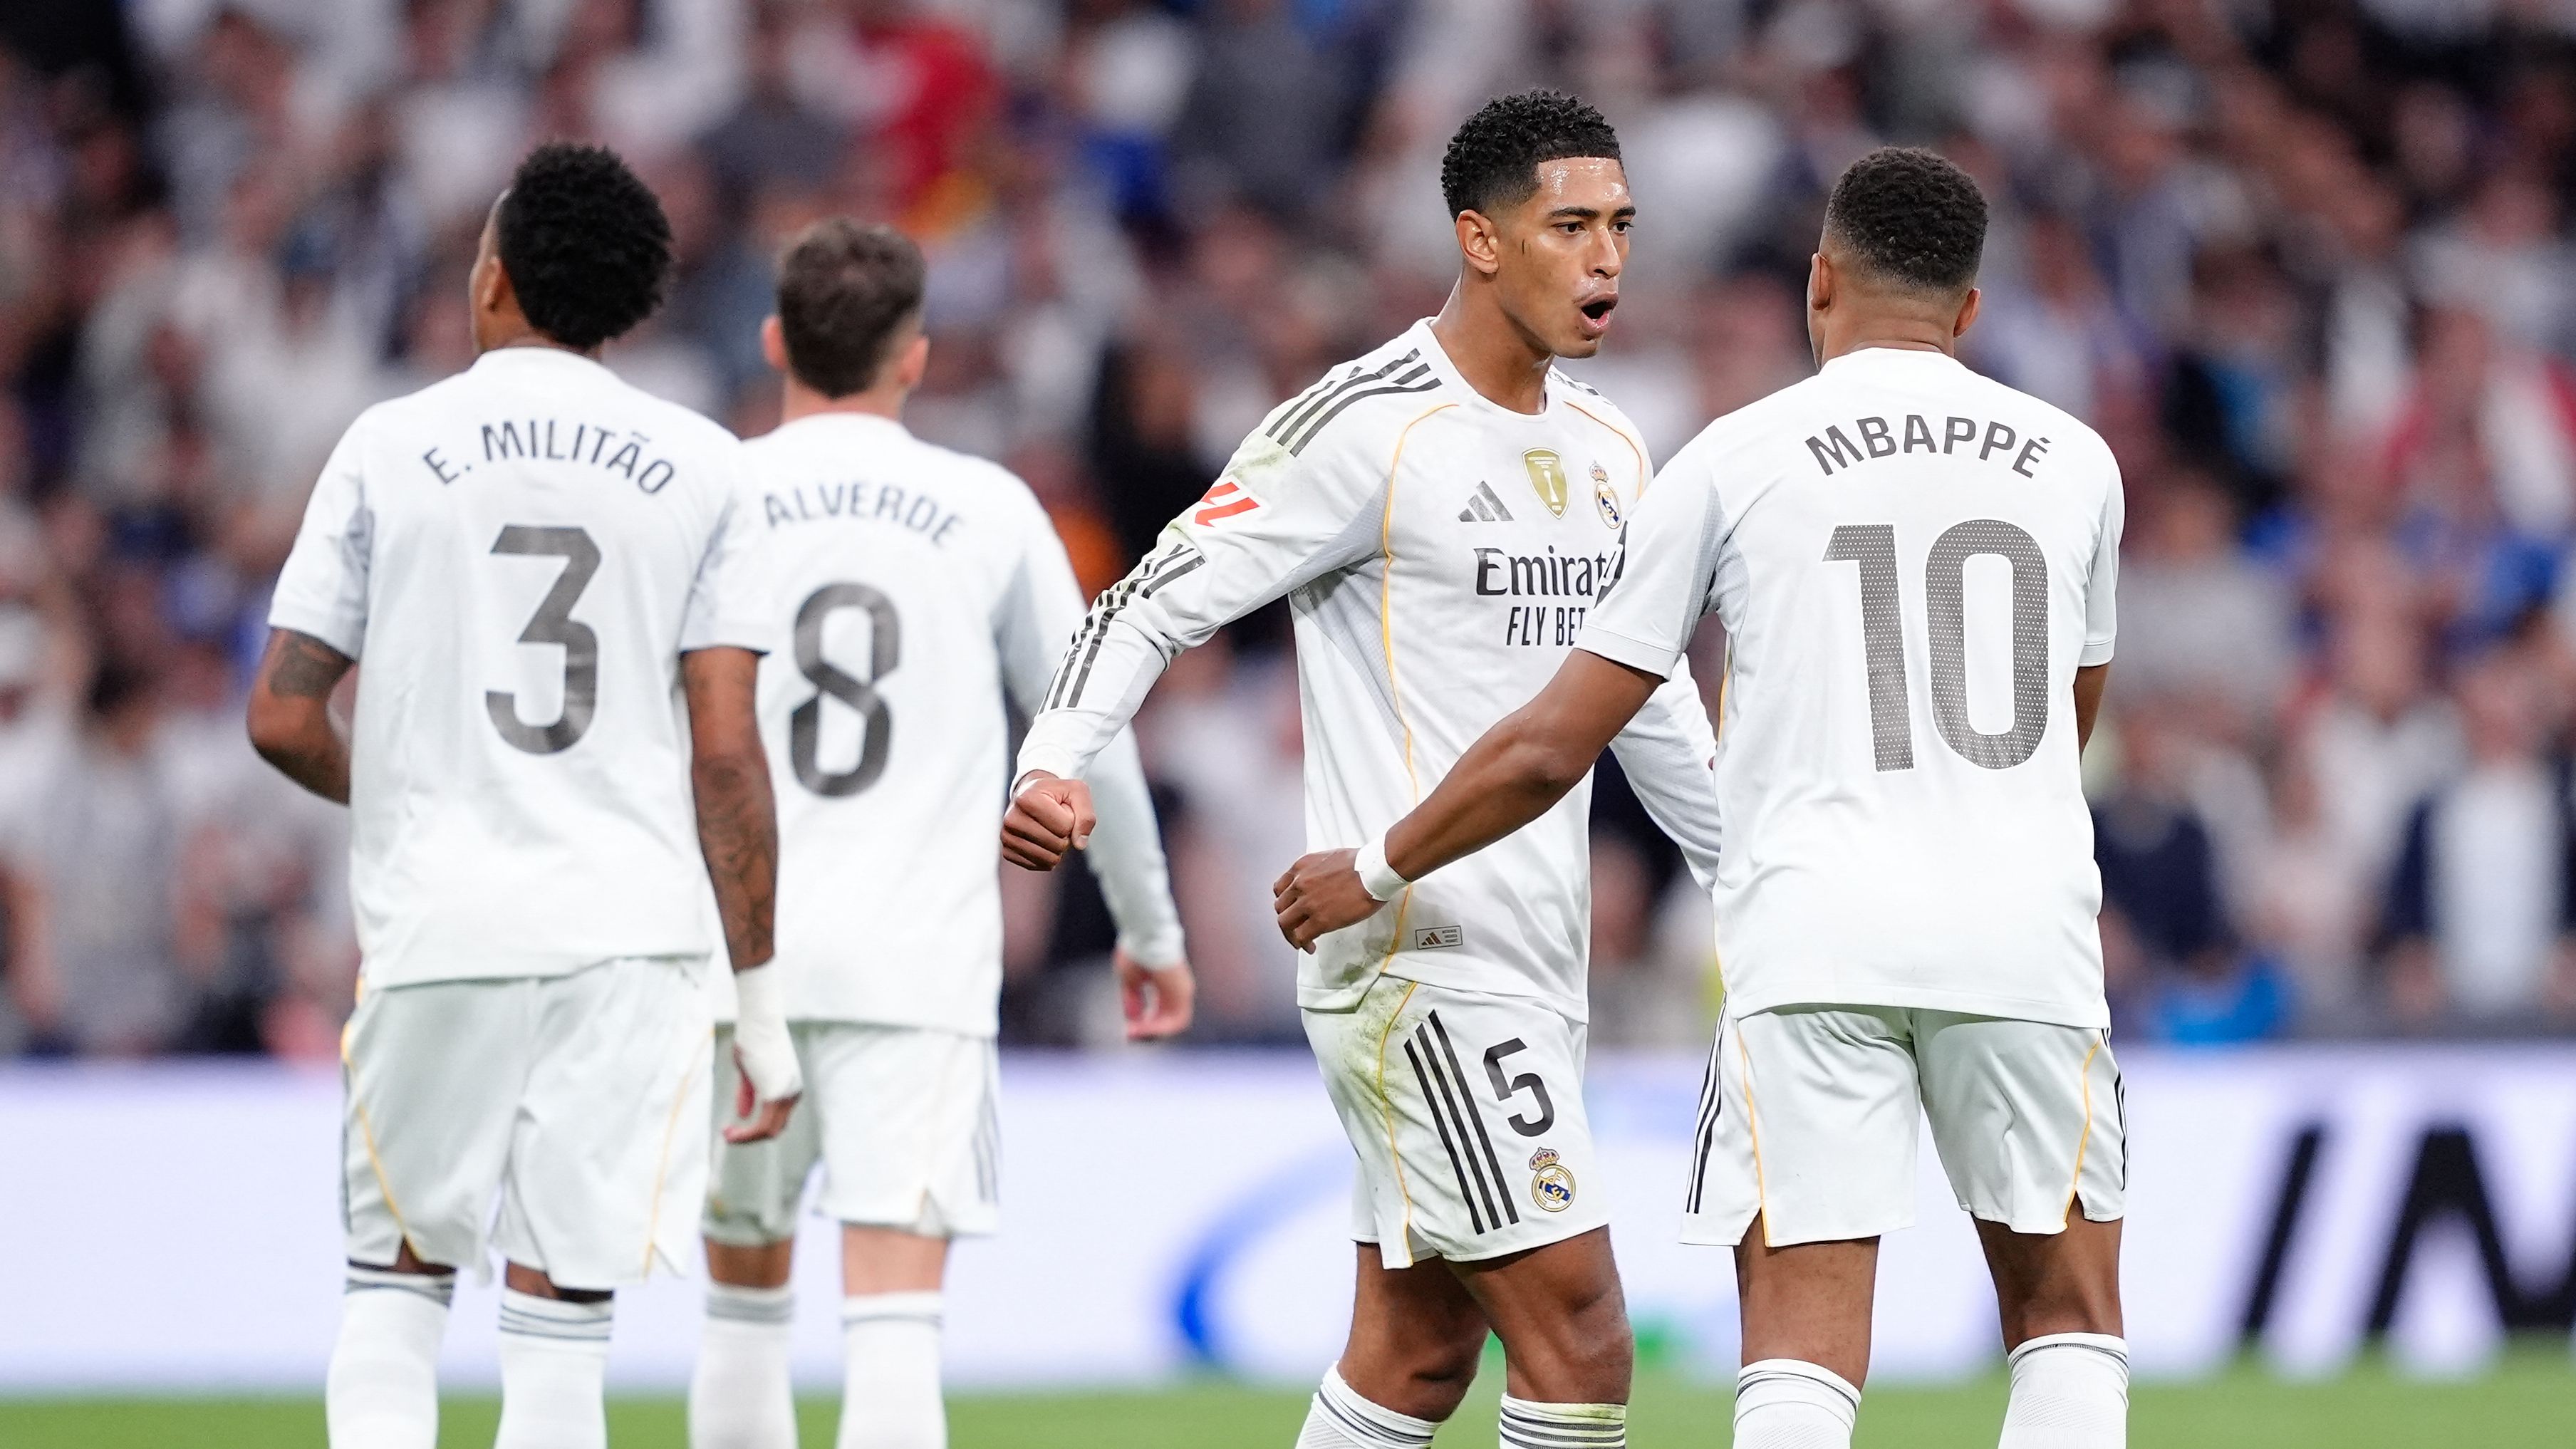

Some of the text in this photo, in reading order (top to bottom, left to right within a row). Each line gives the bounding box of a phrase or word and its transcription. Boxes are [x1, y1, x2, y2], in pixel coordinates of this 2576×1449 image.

[422, 419, 675, 496] E. MILITÃO
[1804, 415, 2052, 479] MBAPPÉ
[764, 482, 965, 549] ALVERDE
[1473, 545, 1606, 596] Emirat
[485, 524, 602, 756] 3
[1507, 606, 1589, 646] FLY BET
[1822, 519, 2048, 772] 10
[789, 583, 900, 799] 8
[1483, 1037, 1555, 1137] 5
